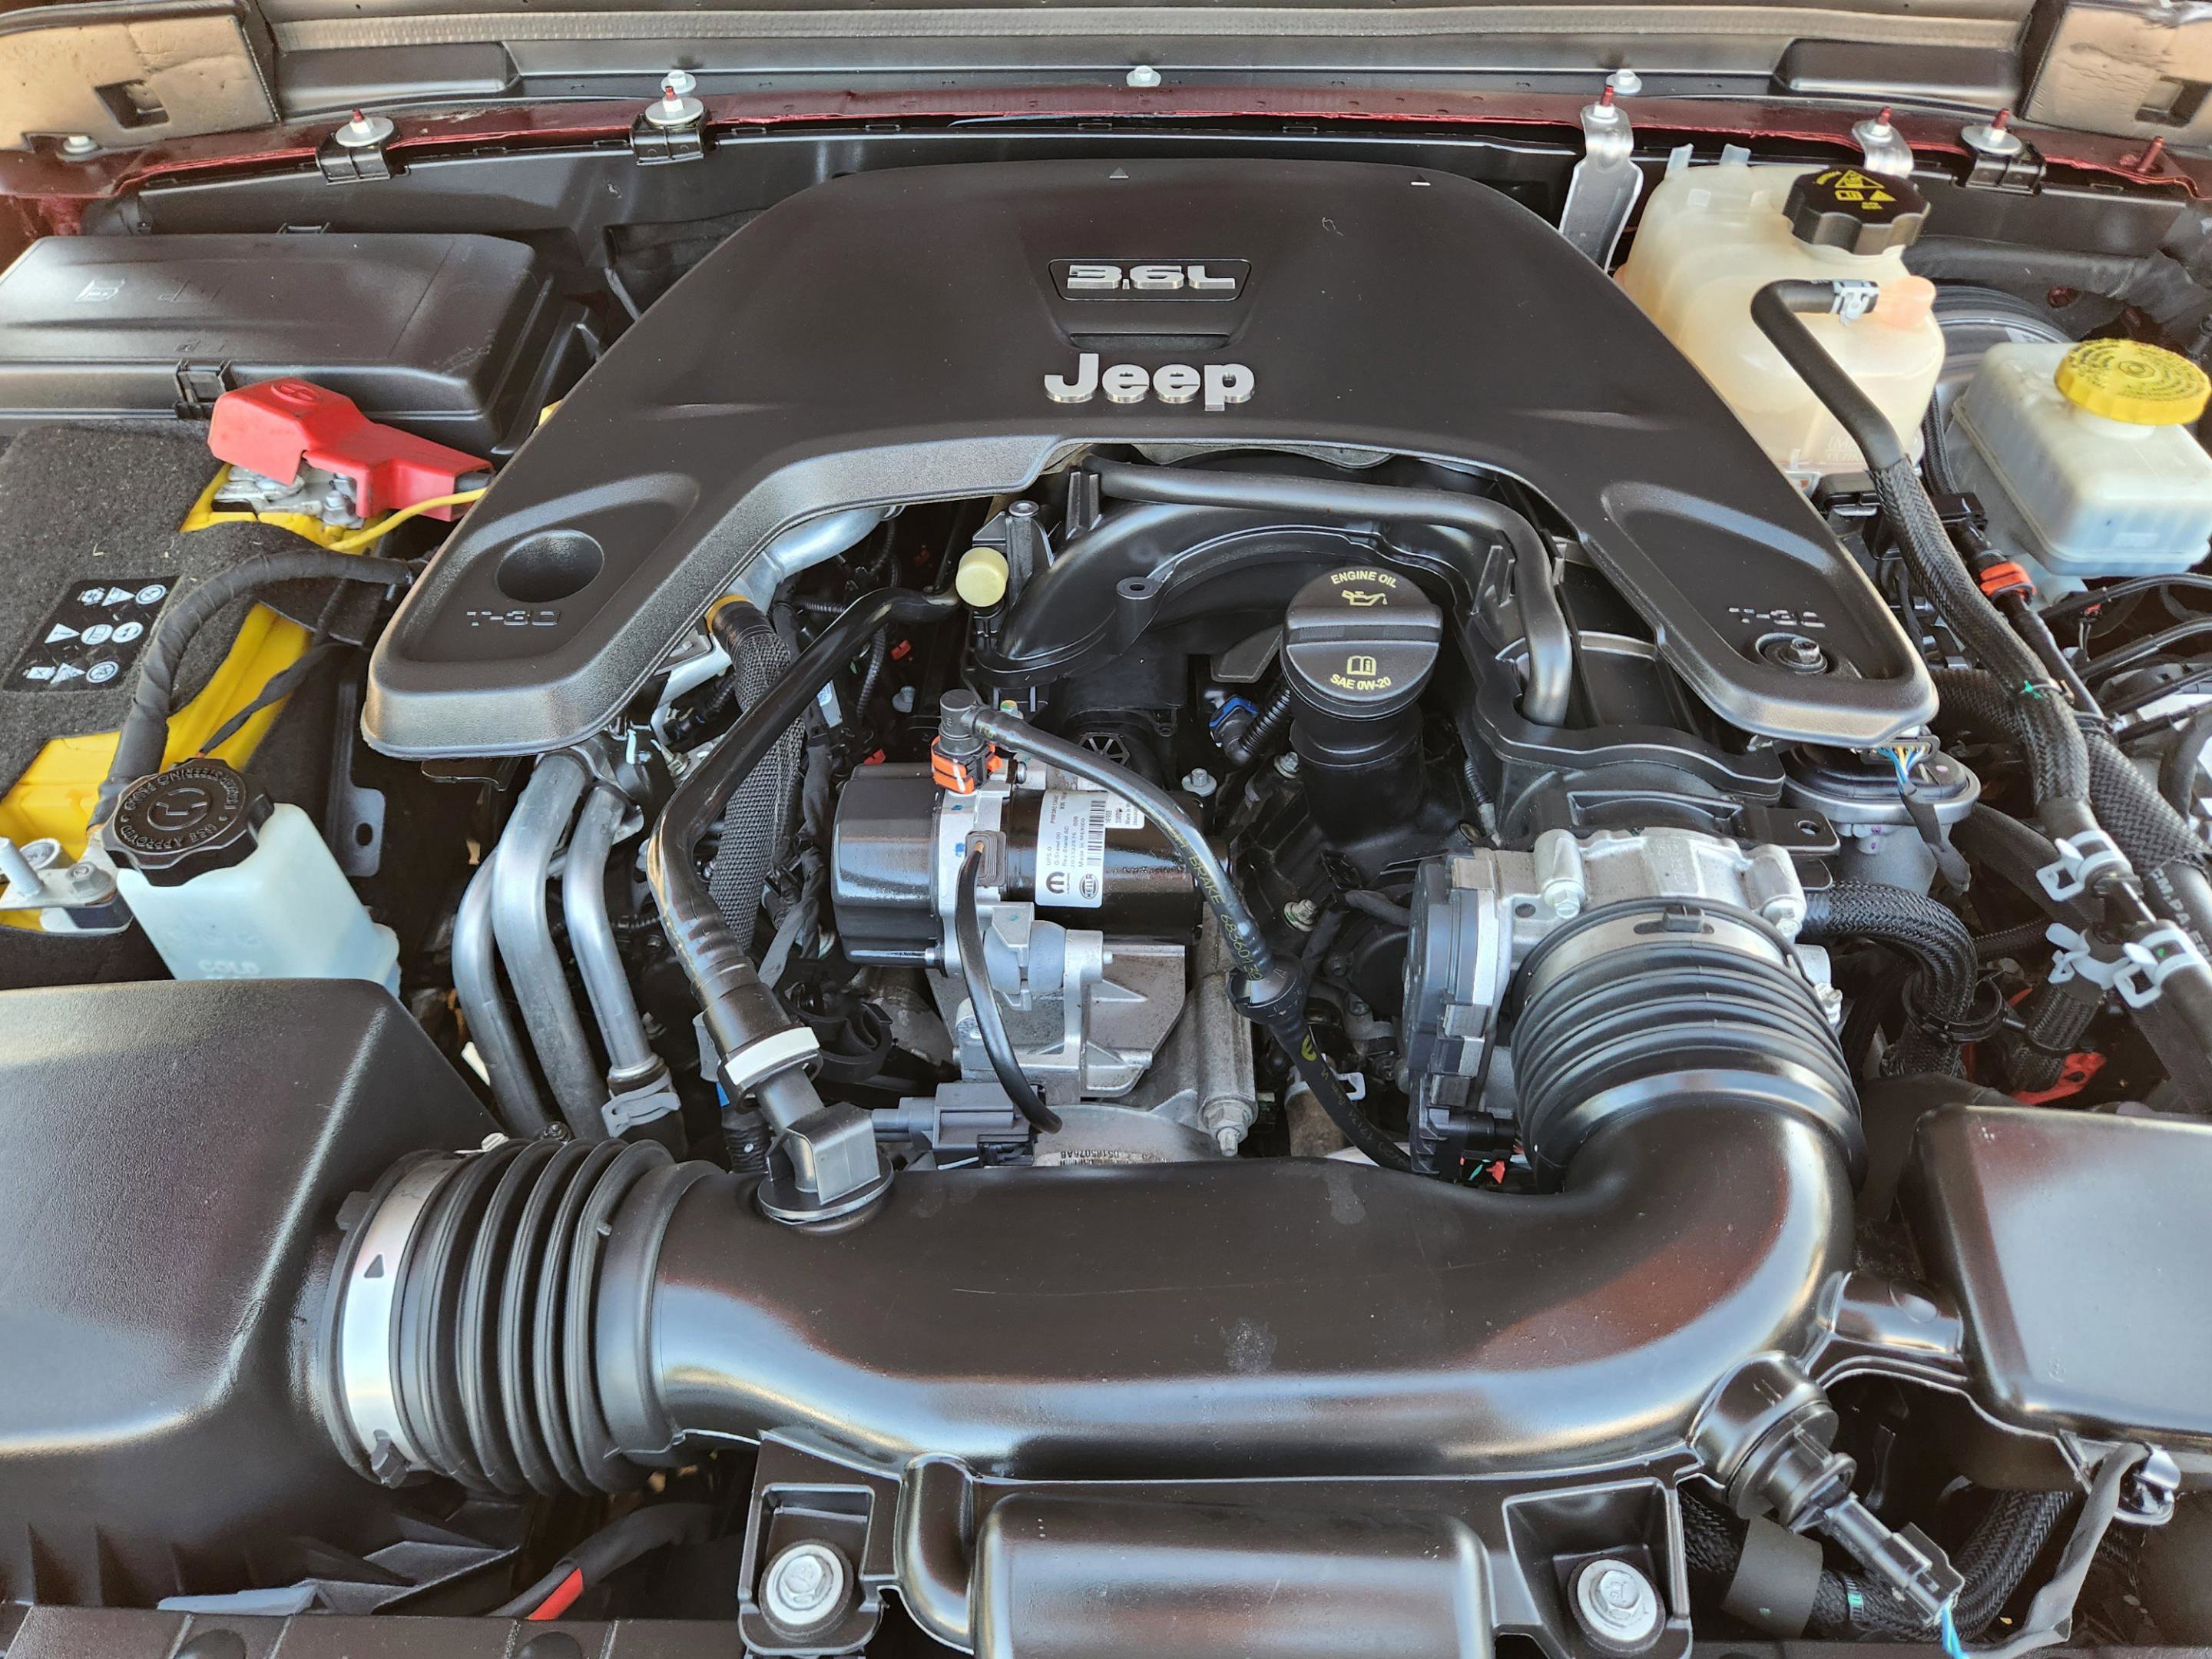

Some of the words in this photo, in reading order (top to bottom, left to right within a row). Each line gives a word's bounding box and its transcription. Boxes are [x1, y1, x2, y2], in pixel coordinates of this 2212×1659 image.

[1067, 264, 1236, 290] 3.6L
[1044, 353, 1255, 412] Jeep
[1330, 570, 1377, 584] ENGINE
[1378, 574, 1397, 588] OIL
[1330, 674, 1356, 690] SAE
[1356, 676, 1392, 690] 0W-20
[1188, 855, 1226, 905] BRAKE
